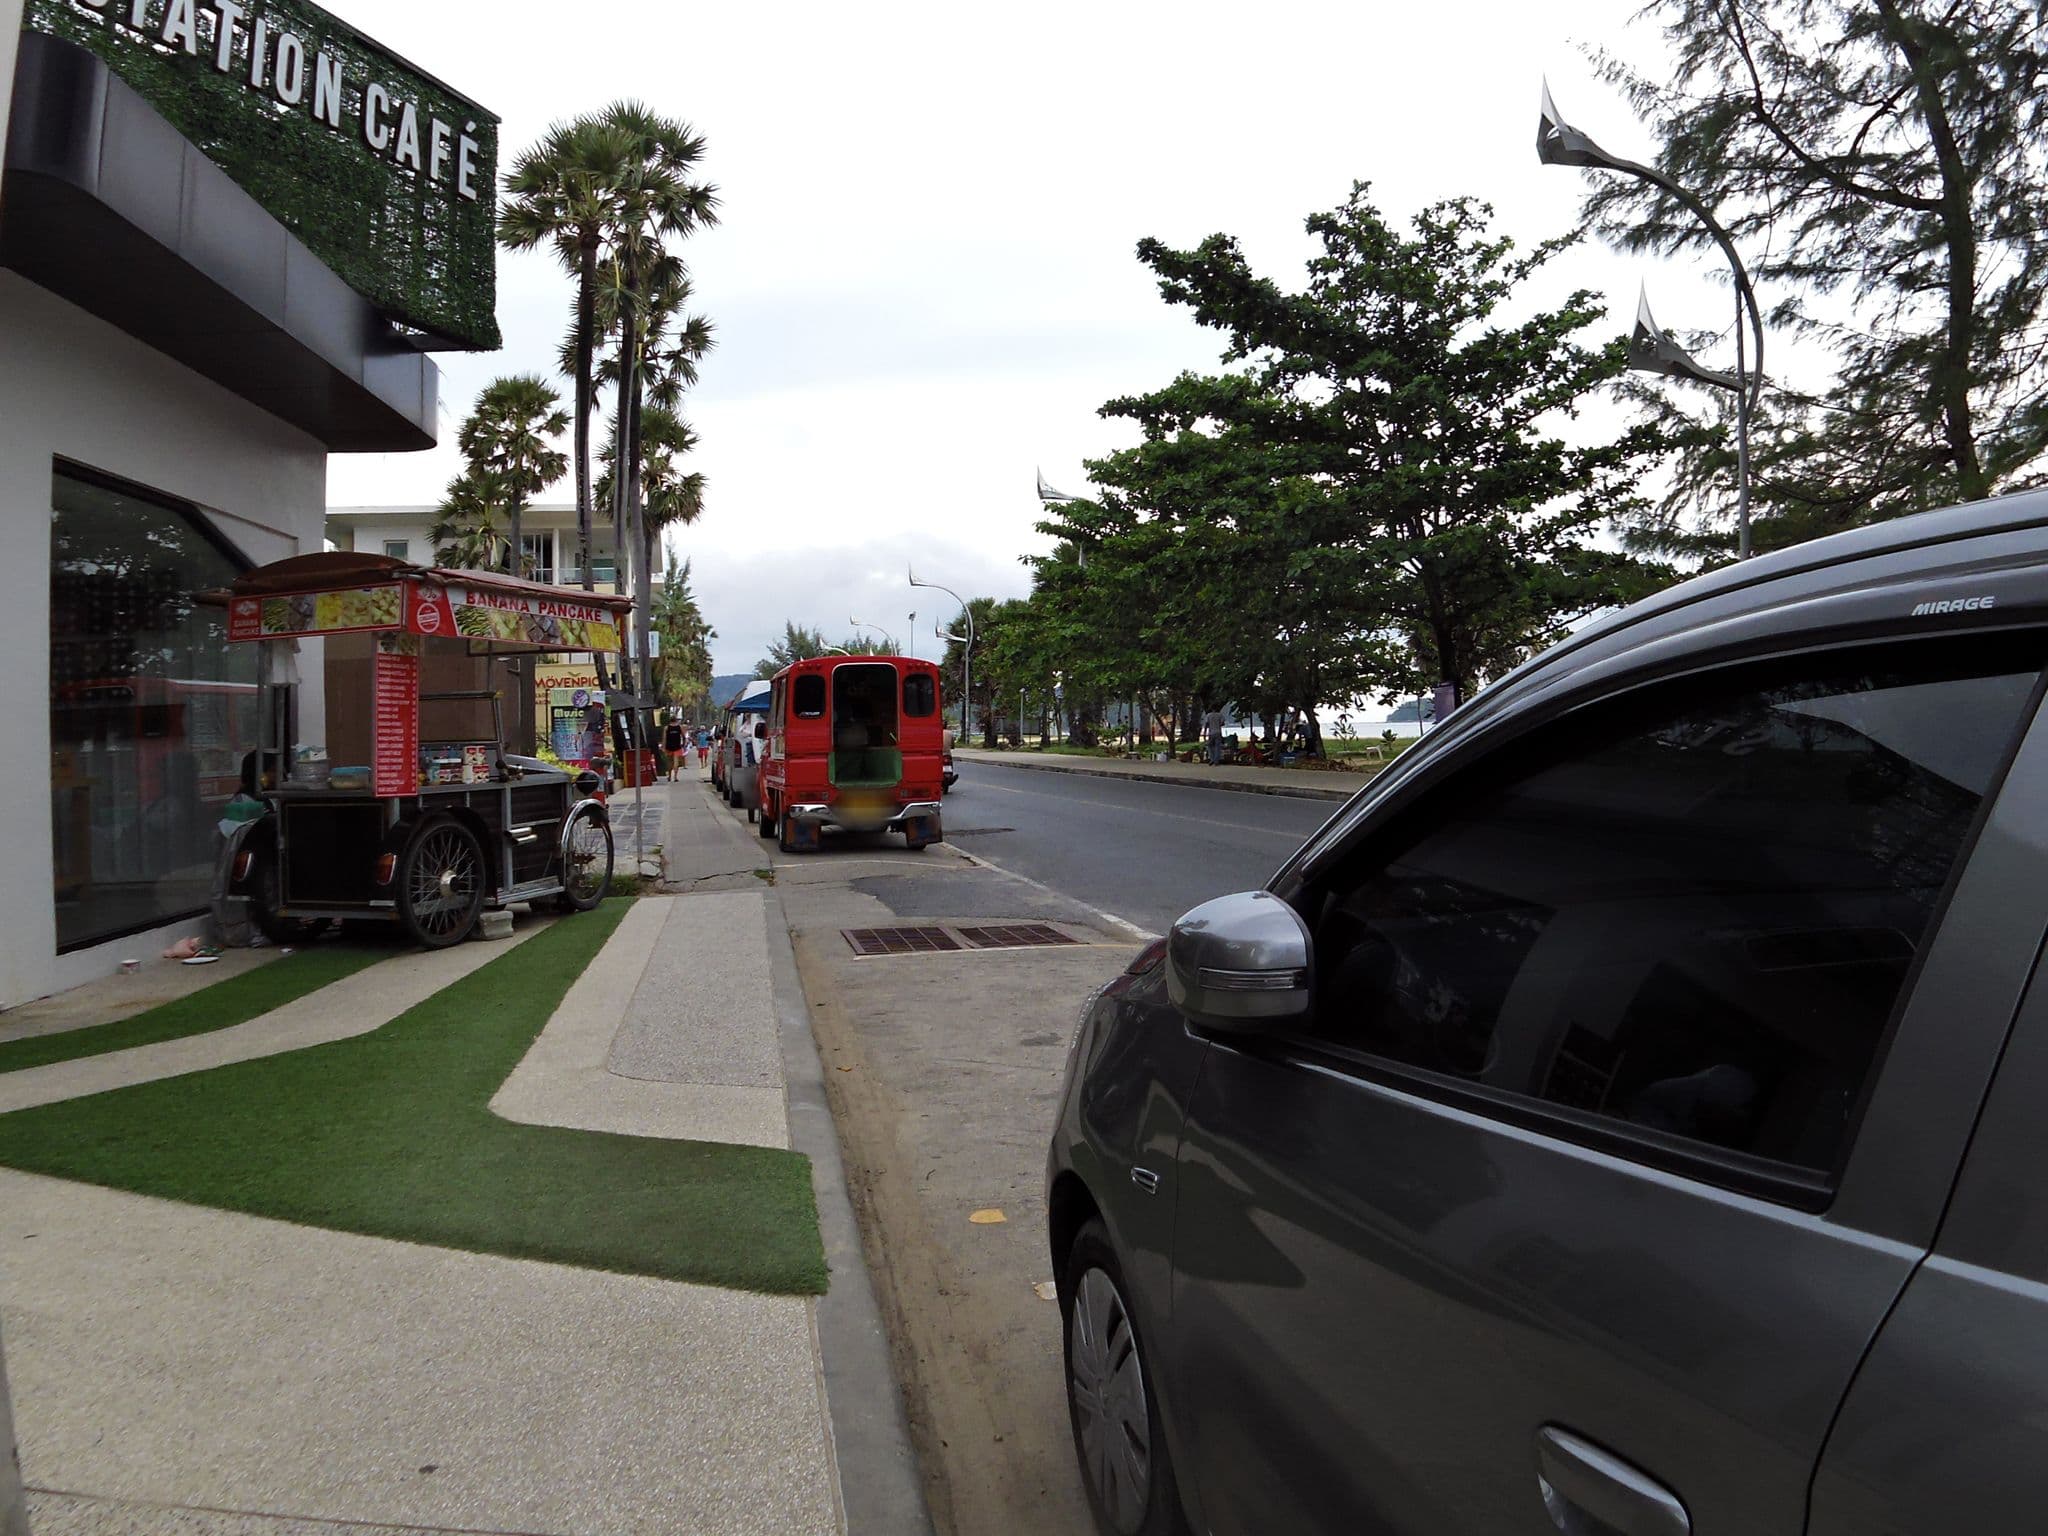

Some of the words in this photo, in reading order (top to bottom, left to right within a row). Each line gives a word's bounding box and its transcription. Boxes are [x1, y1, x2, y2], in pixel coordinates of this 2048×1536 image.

[83, 0, 342, 127] ATION
[365, 83, 479, 200] CAFÉ
[466, 591, 530, 612] BANANA
[538, 601, 602, 622] PANCAKE
[1911, 596, 1995, 616] MIRAGE
[554, 708, 584, 718] Music
